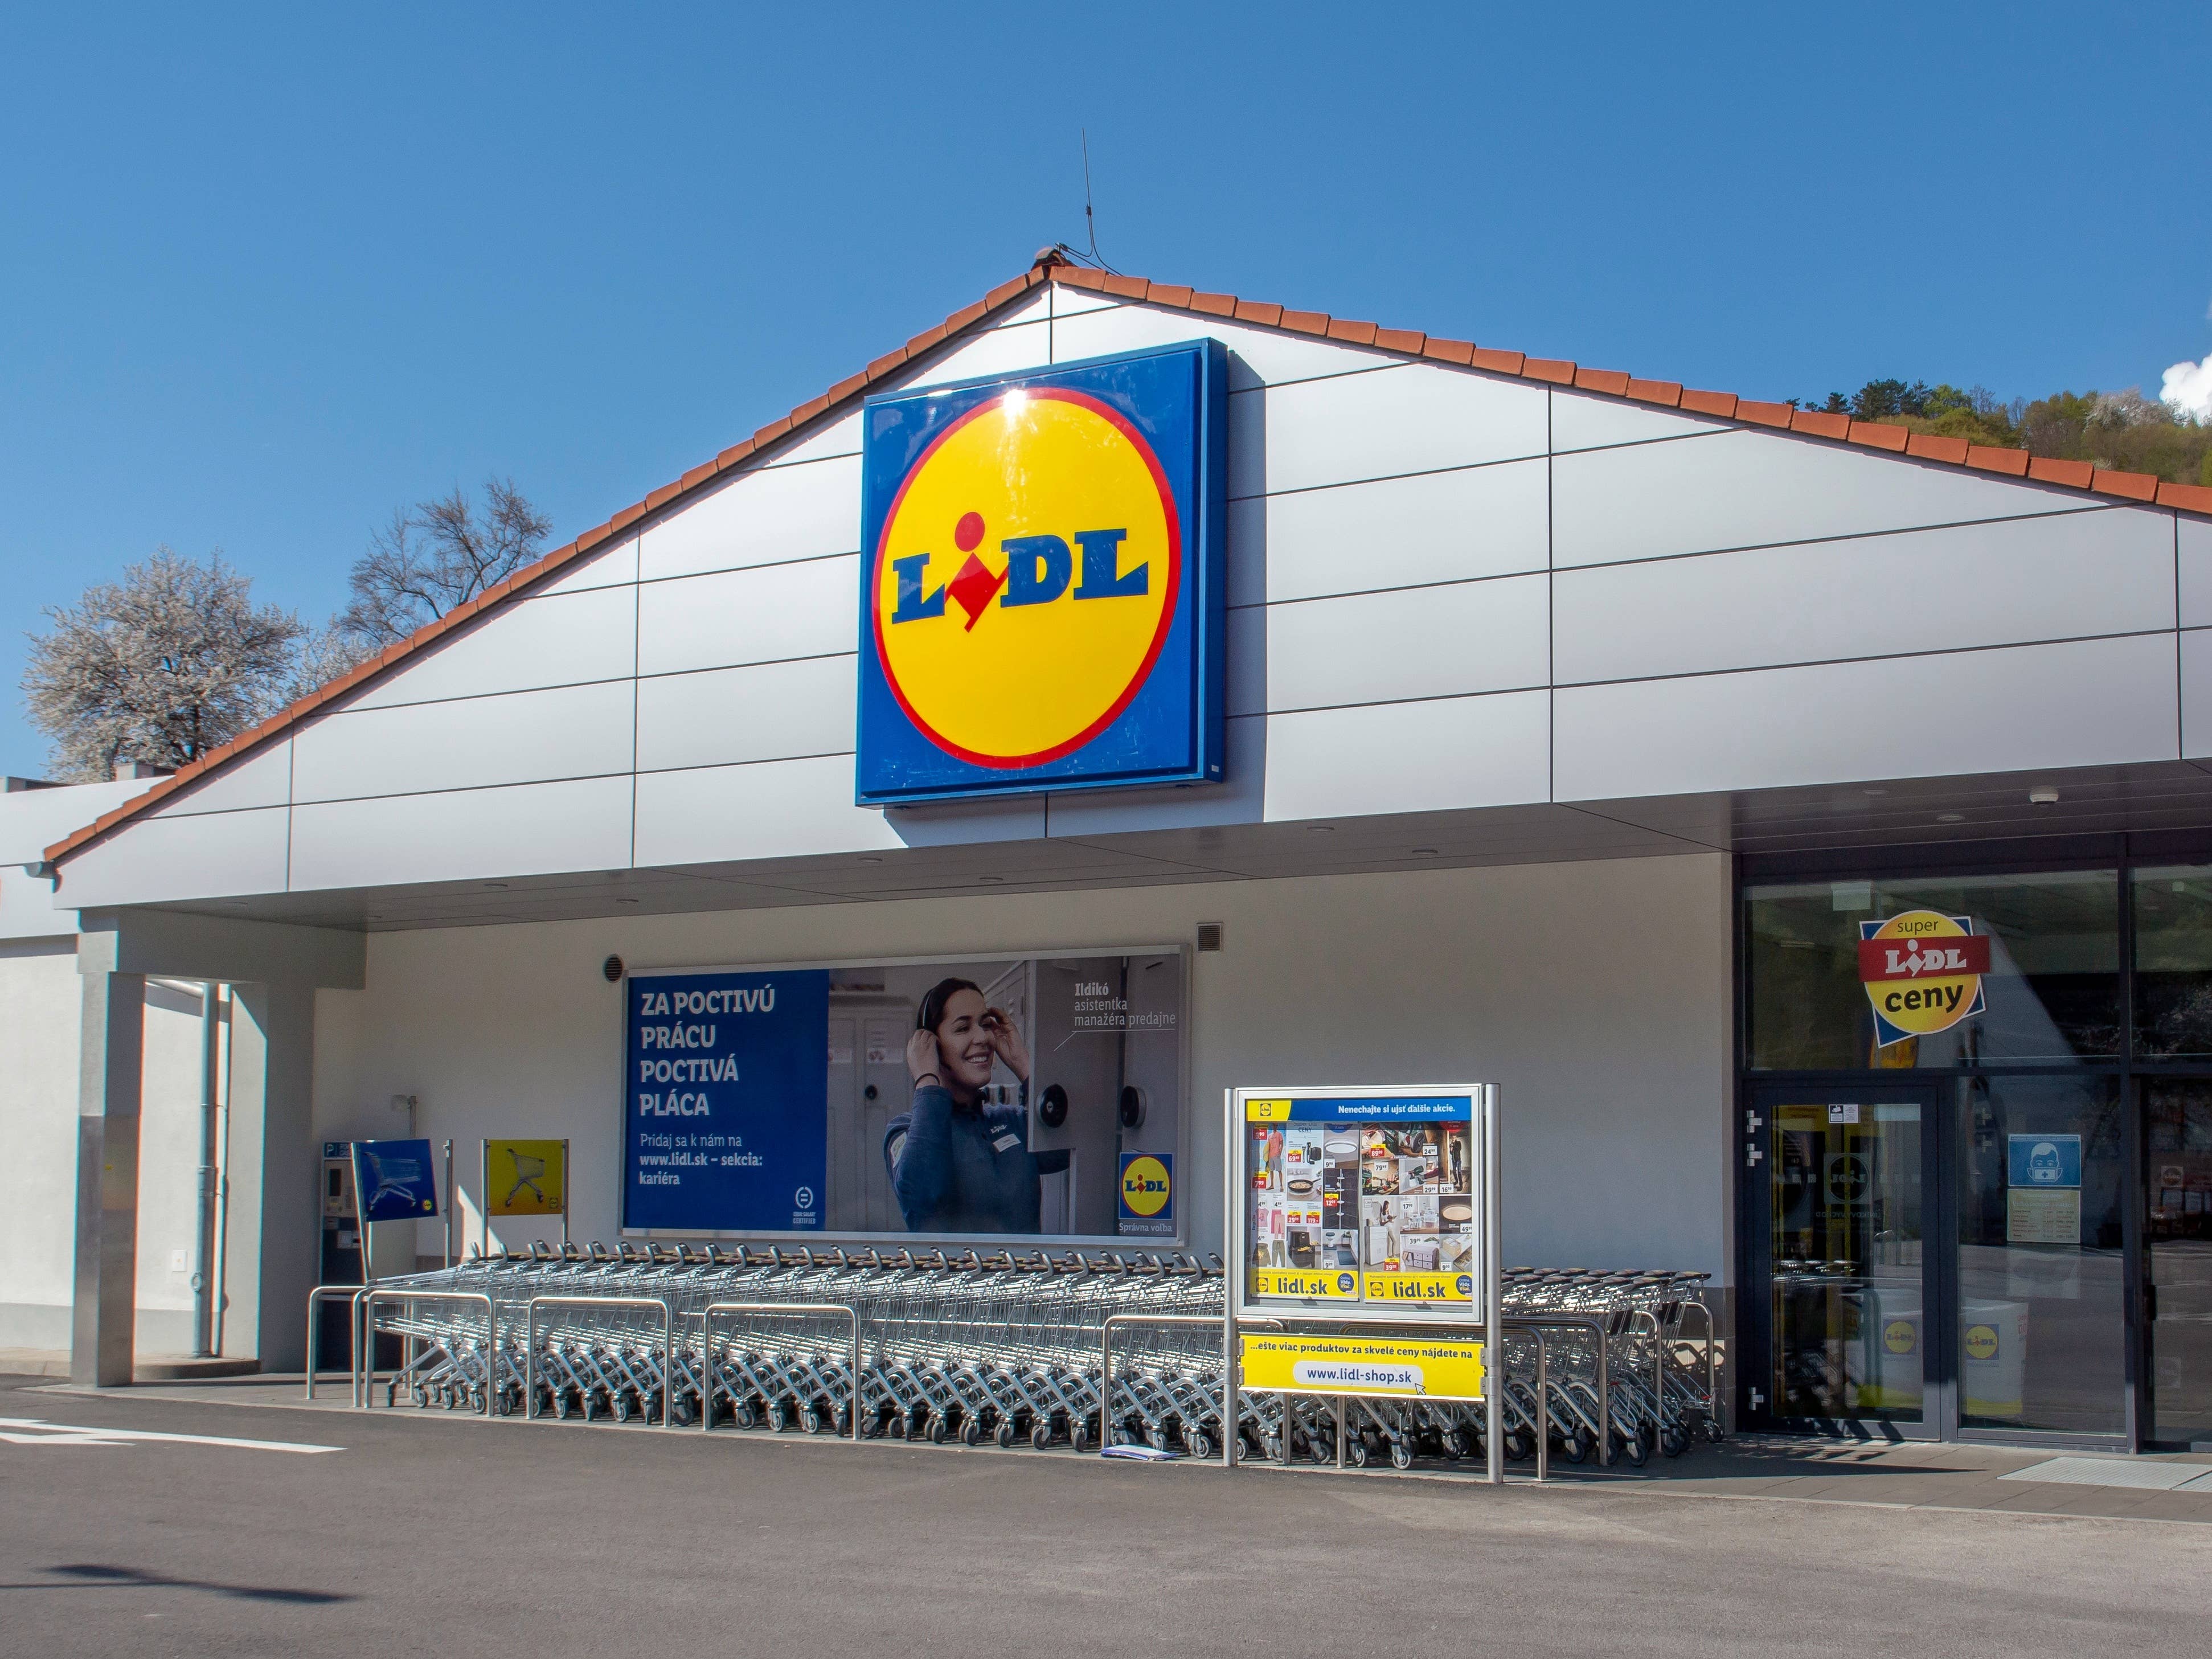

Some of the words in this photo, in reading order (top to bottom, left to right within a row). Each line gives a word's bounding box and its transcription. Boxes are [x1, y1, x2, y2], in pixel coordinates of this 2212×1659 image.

[1897, 920, 1939, 936] super
[1075, 982, 1109, 997] Ildikó
[641, 992, 670, 1015] ZA
[673, 984, 775, 1015] POCTIVÚ
[1075, 997, 1128, 1011] asistentka
[1885, 984, 1964, 1014] ceny
[1074, 1012, 1125, 1026] manažéra
[1128, 1011, 1176, 1029] predajne
[641, 1021, 716, 1049] PRÁCU
[640, 1053, 739, 1083] POCTIVÁ
[639, 1088, 710, 1116] PLÁCA
[1338, 1105, 1382, 1115] Nenechajte
[1382, 1105, 1390, 1113] si
[1391, 1104, 1406, 1115] ujsť
[1407, 1104, 1431, 1113] ďalšie
[1432, 1103, 1456, 1112] akcie.
[640, 1133, 673, 1150] Pridaj
[675, 1137, 688, 1146] sa
[691, 1133, 698, 1146] k
[700, 1133, 725, 1146] nám
[728, 1136, 743, 1146] na
[638, 1151, 708, 1166] www.lidl.sk
[720, 1152, 763, 1166] sekcia:
[638, 1170, 680, 1185] kariéra
[1119, 1222, 1149, 1233] Správna
[1150, 1222, 1172, 1232] voľba
[1277, 1277, 1328, 1295] lidl.sk
[1394, 1281, 1446, 1298] lidl.sk
[1279, 1342, 1298, 1351] viac
[1300, 1343, 1350, 1353] produktov
[1365, 1345, 1394, 1355] skvelé
[1396, 1349, 1419, 1358] ceny
[1422, 1347, 1459, 1359] nájdete
[1307, 1368, 1412, 1384] www.lidl-shop.sk
